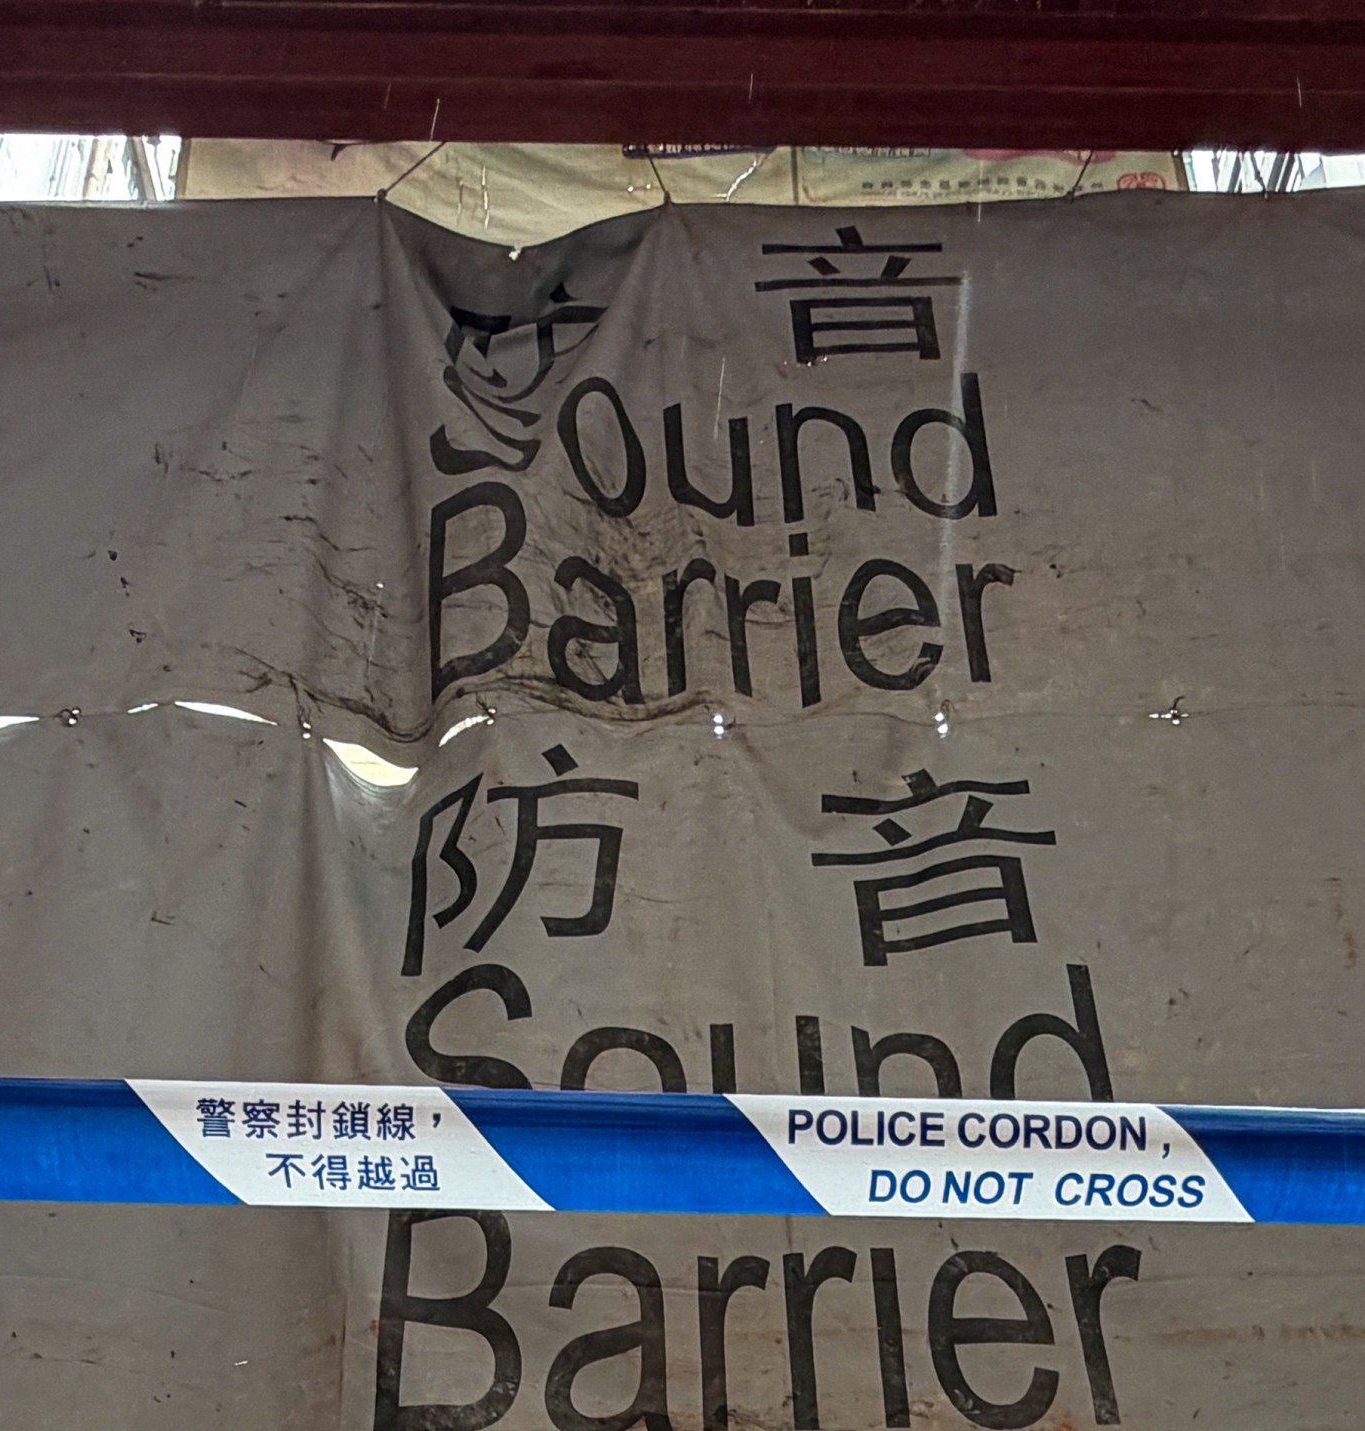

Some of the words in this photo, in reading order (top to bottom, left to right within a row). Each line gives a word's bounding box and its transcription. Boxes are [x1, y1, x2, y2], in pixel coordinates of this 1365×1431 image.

[430, 366, 997, 526] Sound
[430, 481, 1020, 708] Barrier
[401, 745, 1057, 976] 防音
[266, 1154, 440, 1192] 不得越過
[788, 1109, 945, 1147] POLICE
[869, 1170, 930, 1203] DO
[942, 1172, 1033, 1205] NOT
[1055, 1173, 1206, 1208] CROSS
